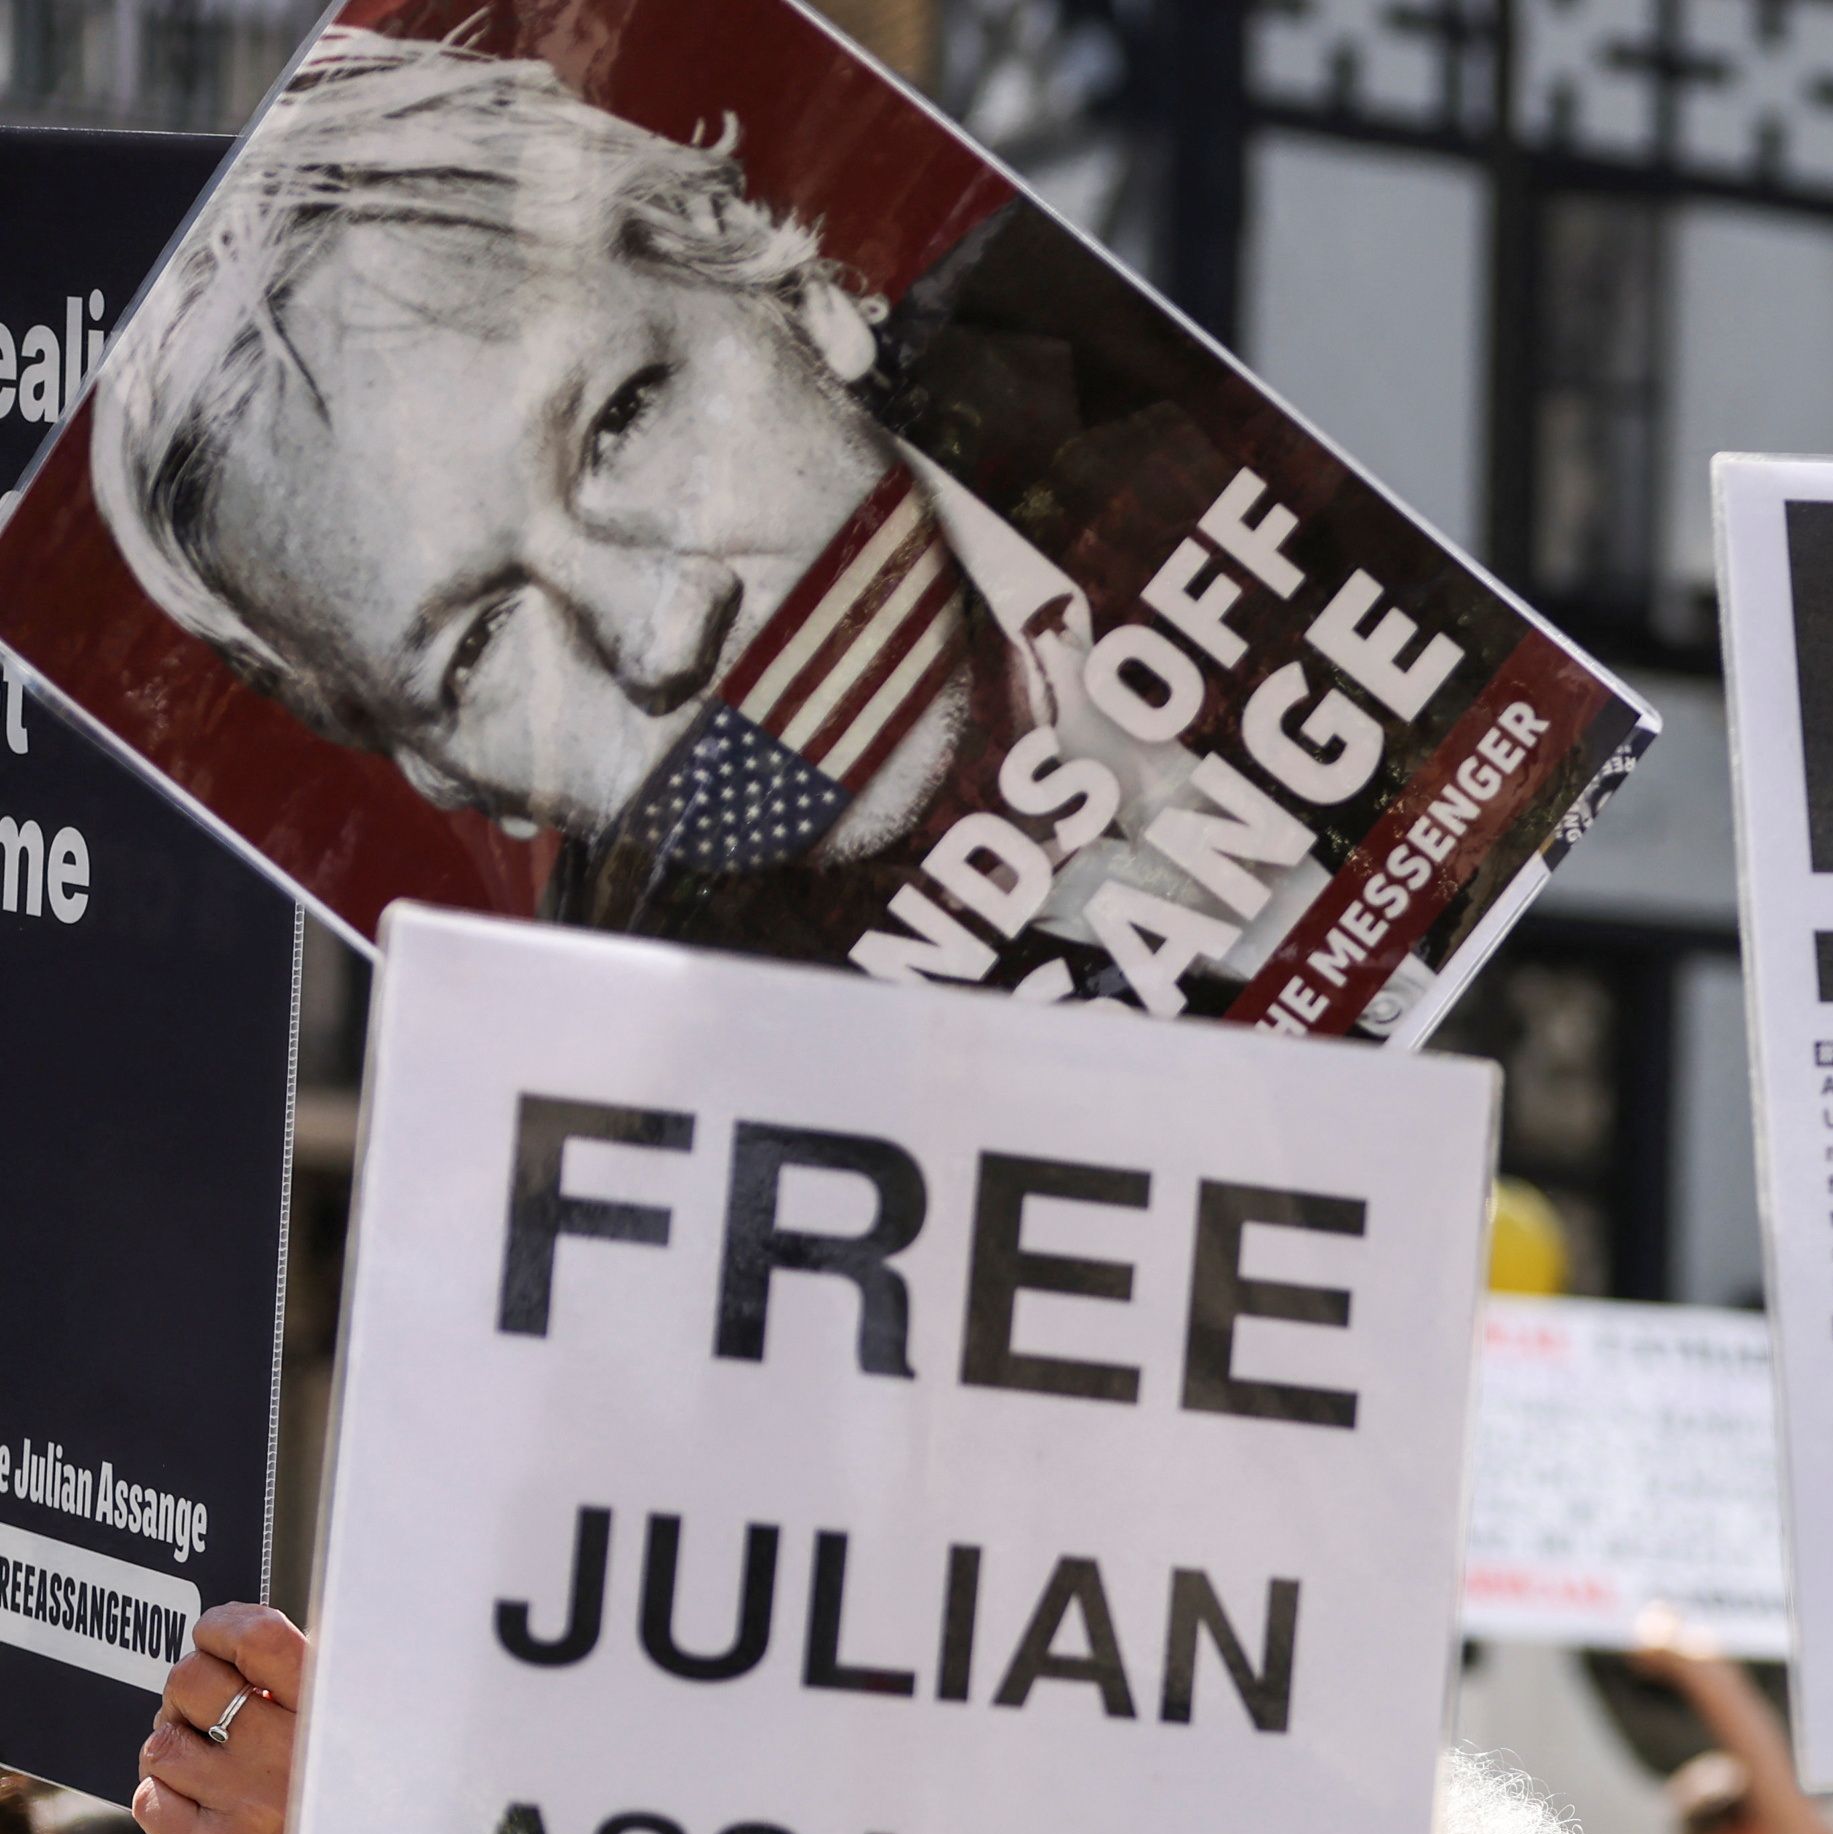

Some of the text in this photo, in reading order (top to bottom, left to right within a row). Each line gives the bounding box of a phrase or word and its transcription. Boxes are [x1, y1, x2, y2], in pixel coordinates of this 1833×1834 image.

[1082, 465, 1307, 743] OFF
[1306, 701, 1550, 987] MESSENGER
[498, 1094, 1367, 1430] FREE
[14, 1438, 92, 1518] Julian
[95, 1461, 207, 1563] Assange
[494, 1505, 1299, 1733] JULIAN
